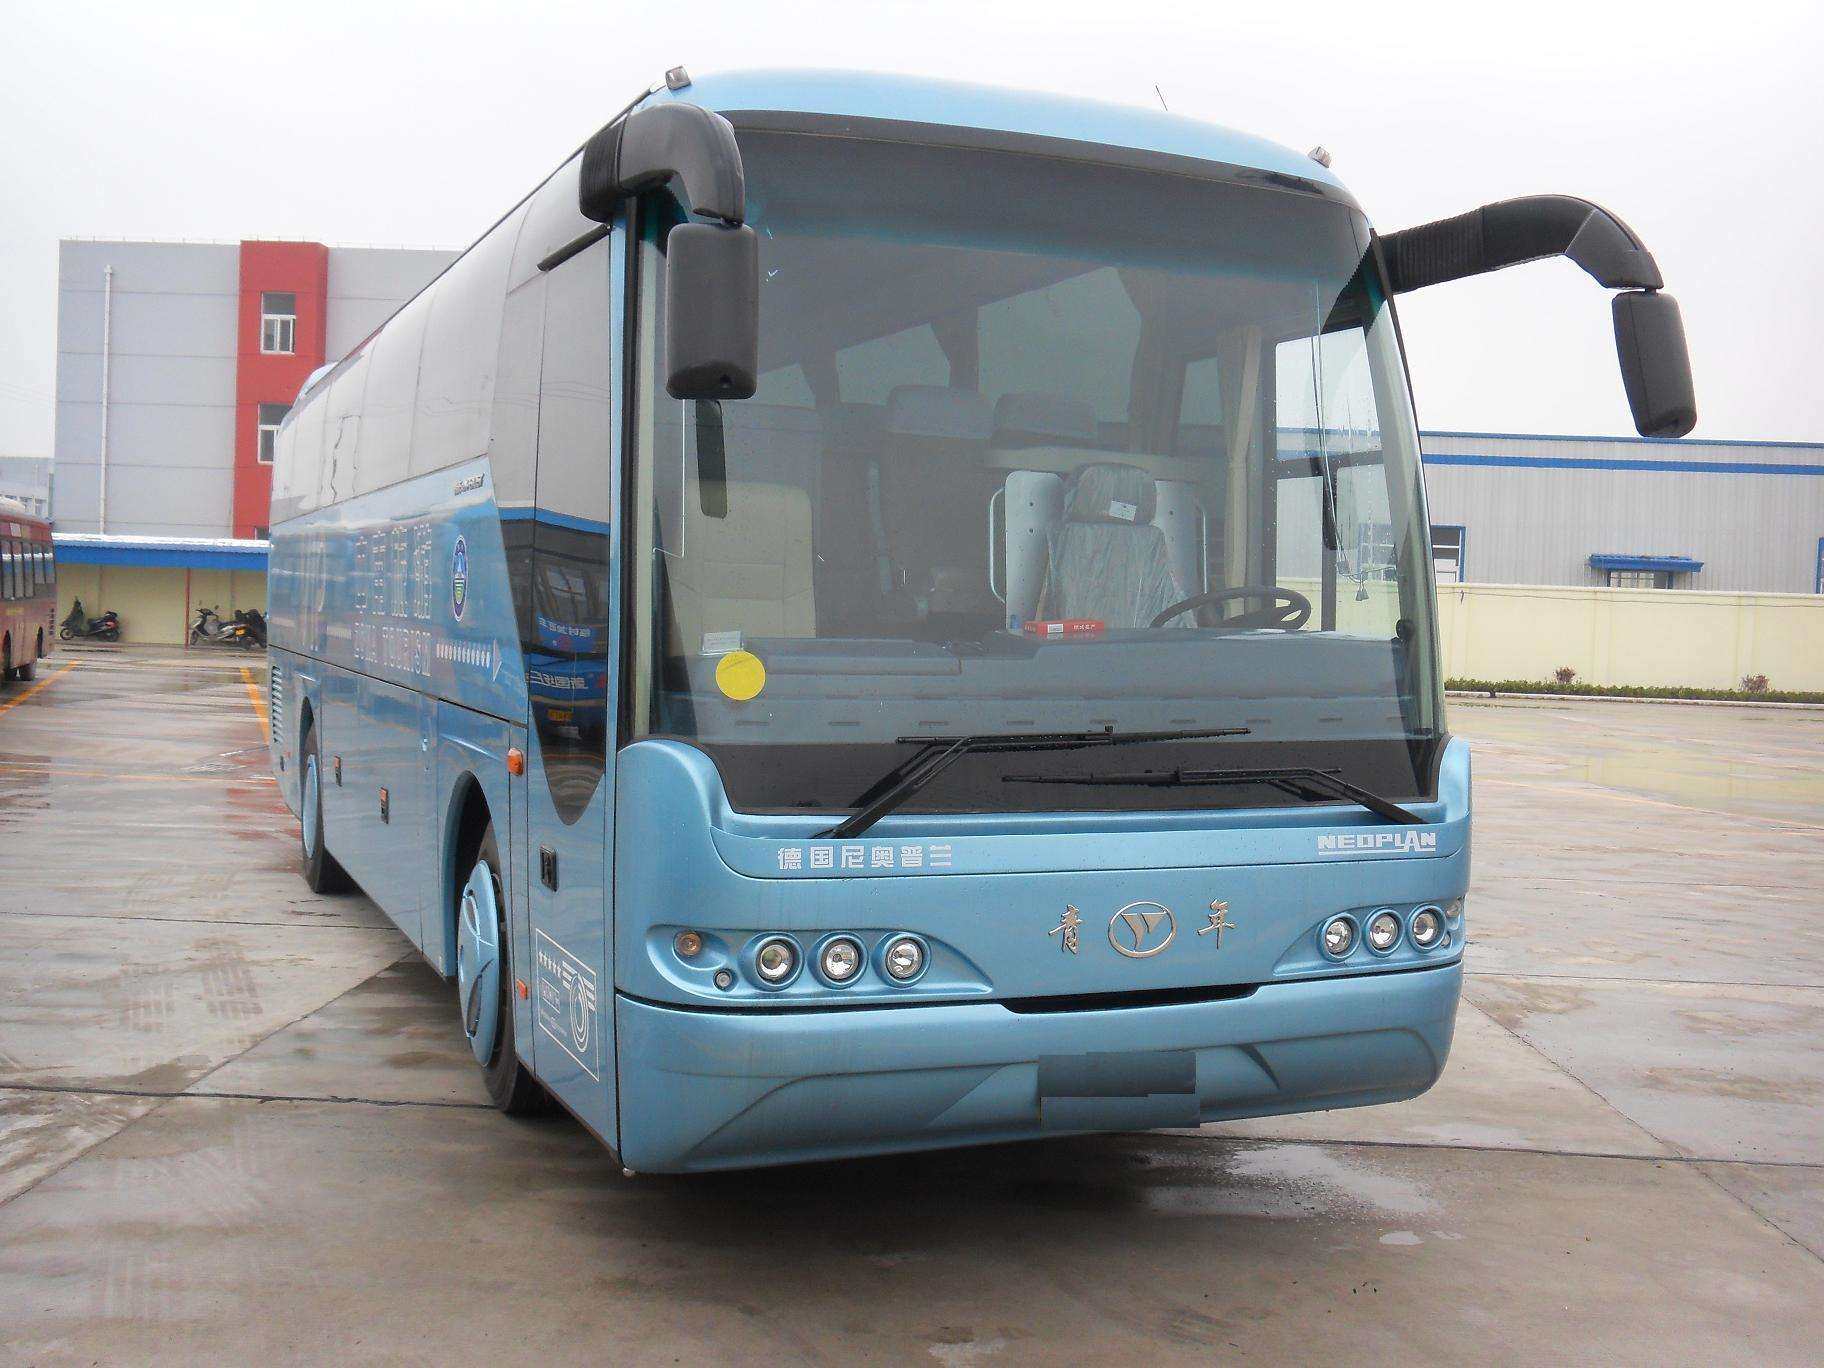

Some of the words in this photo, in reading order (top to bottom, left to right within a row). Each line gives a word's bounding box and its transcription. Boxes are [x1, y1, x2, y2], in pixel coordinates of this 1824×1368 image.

[1317, 830, 1436, 851] NEOPLAN
[778, 845, 951, 870] 德国尼奥普兰
